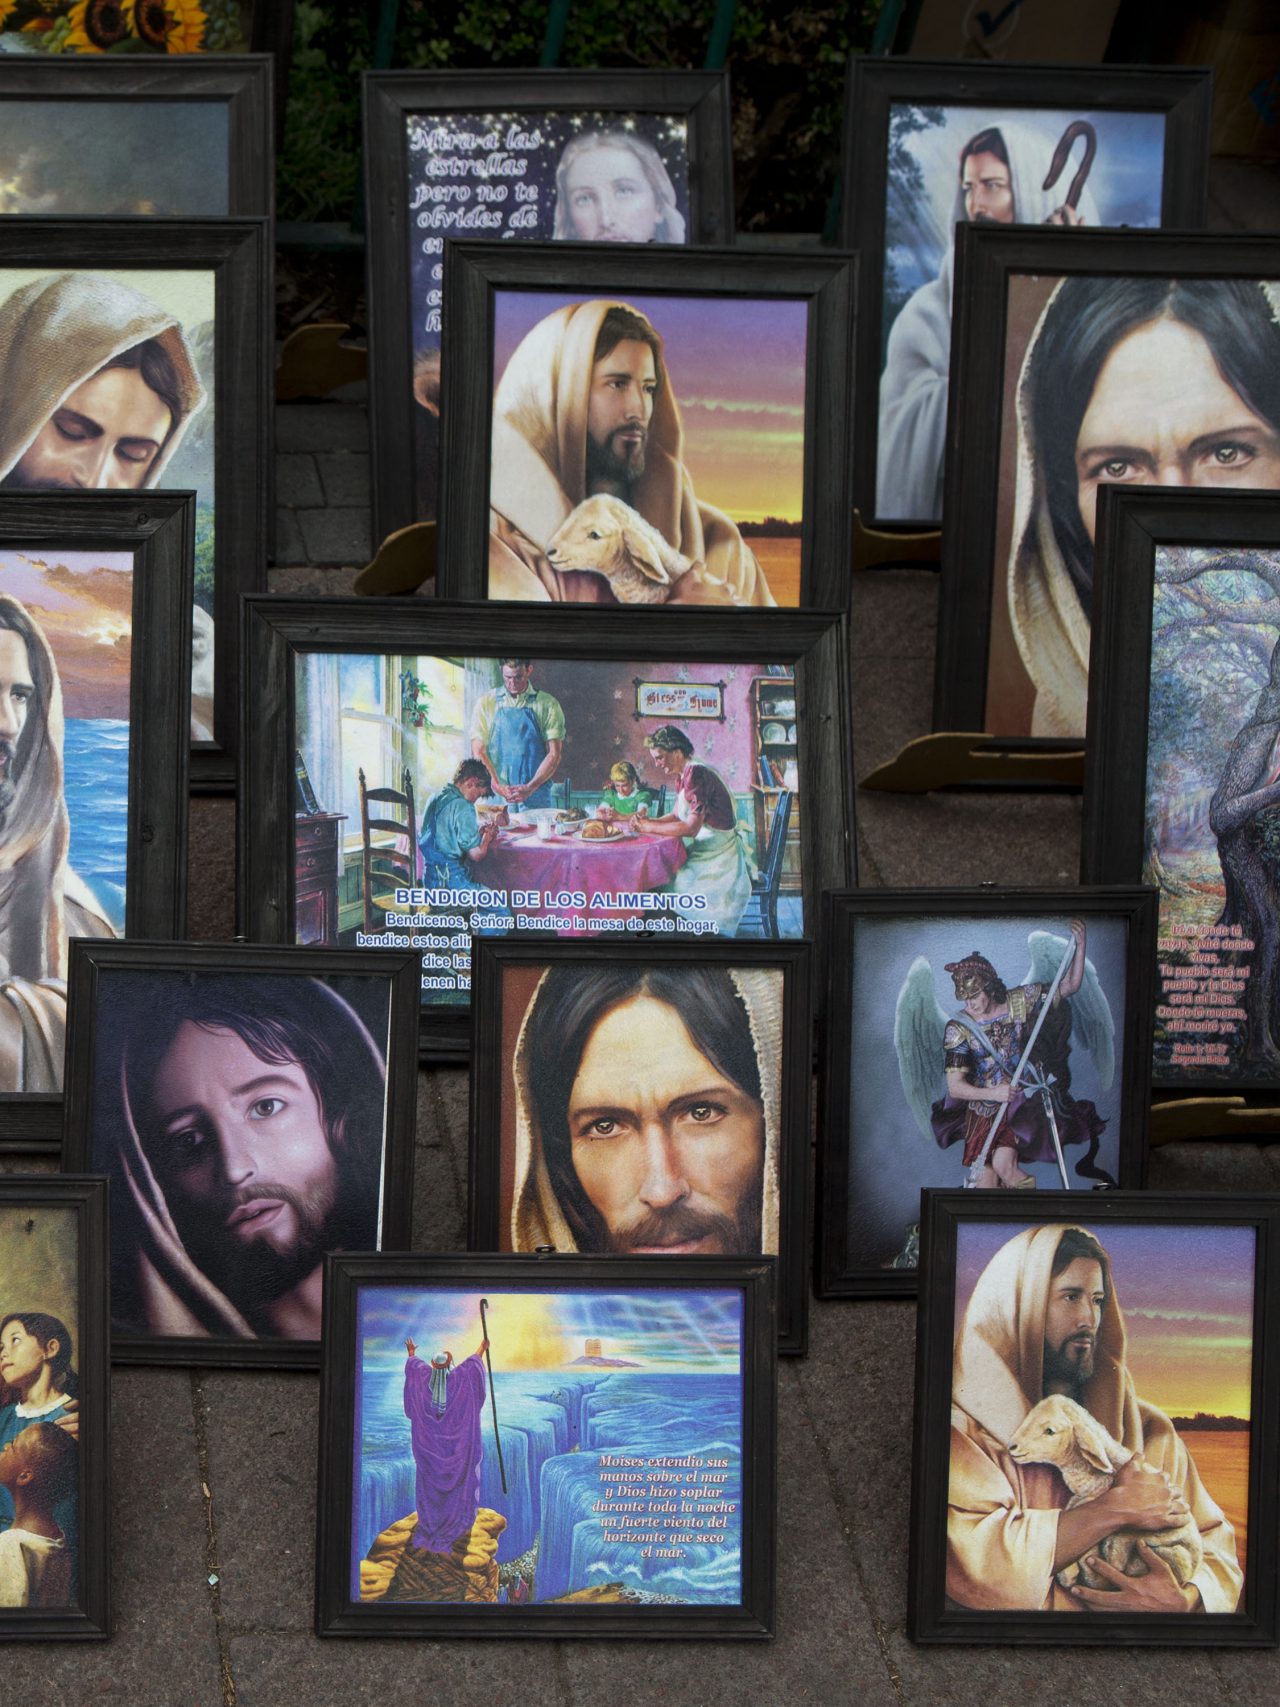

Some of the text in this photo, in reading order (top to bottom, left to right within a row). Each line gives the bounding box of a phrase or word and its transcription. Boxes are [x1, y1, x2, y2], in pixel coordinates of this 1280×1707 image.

[410, 126, 541, 150] Mira a las
[425, 152, 528, 177] estrellas
[409, 182, 539, 209] pero no te
[417, 204, 538, 228] olvides de
[395, 889, 706, 911] BENDICION DE LOS ALIMENTOS
[470, 913, 514, 929] Señor:
[517, 916, 572, 931] Bendice
[574, 916, 586, 930] la
[588, 919, 624, 931] mesa
[627, 918, 644, 932] de
[646, 920, 675, 933] este
[676, 919, 720, 936] hogar,
[356, 932, 410, 947] bendice
[411, 933, 449, 948] estos
[422, 953, 451, 968] dice
[599, 1455, 728, 1468] Moises extendio sus
[599, 1471, 728, 1483] manos sobre el mar
[605, 1485, 723, 1500] y Dios hizo soplar
[592, 1500, 736, 1513] durante toda la noche
[600, 1515, 727, 1530] un fuerte viento del
[603, 1530, 724, 1547] horizonte que seco
[640, 1546, 686, 1558] el mar.
